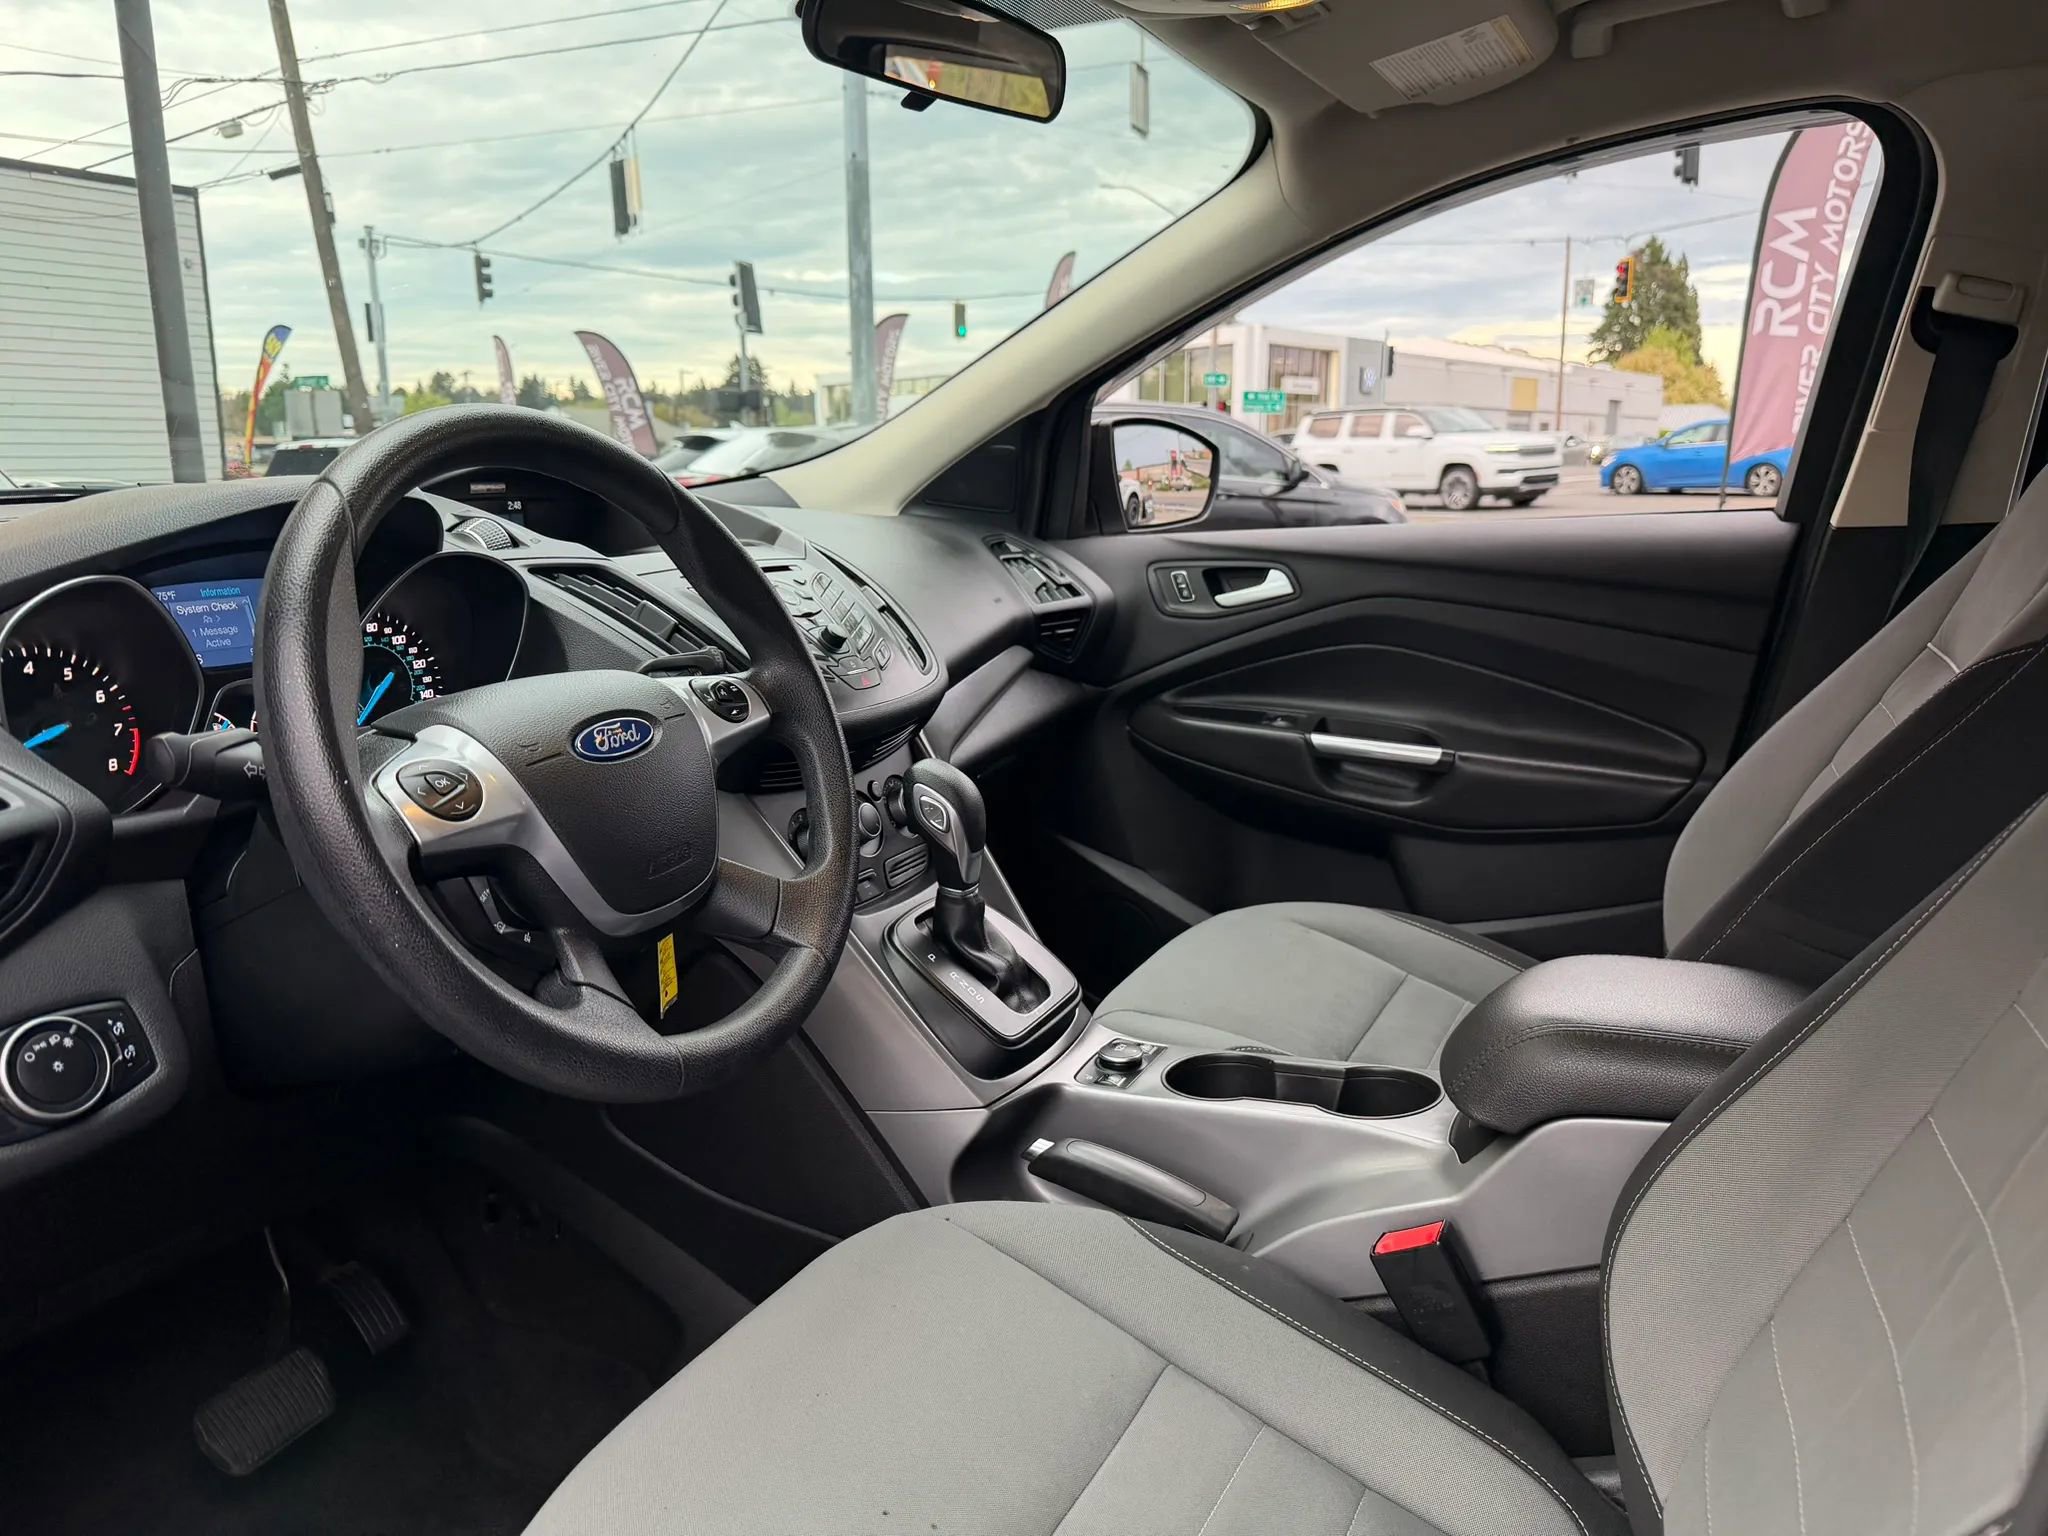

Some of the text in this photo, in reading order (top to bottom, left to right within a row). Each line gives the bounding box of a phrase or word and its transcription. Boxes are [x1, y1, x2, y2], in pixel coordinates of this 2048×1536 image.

[1819, 121, 1872, 256] MOTORS
[1752, 206, 1818, 337] RCM
[1807, 261, 1835, 335] CITY
[604, 381, 622, 412] CITY
[615, 376, 649, 431] RCM
[200, 586, 241, 597] Information
[176, 600, 239, 616] System Check
[199, 624, 239, 637] Message
[366, 623, 378, 632] 80
[205, 637, 232, 648] Active
[392, 635, 406, 645] 100
[23, 660, 34, 675] 4
[412, 659, 426, 669] 120
[63, 667, 73, 681] 5
[96, 690, 106, 703] 6
[420, 689, 434, 699] 140
[114, 722, 123, 736] 7
[593, 722, 641, 752] Ford
[108, 758, 118, 772] 8
[434, 777, 451, 788] OK
[928, 953, 936, 963] P
[950, 971, 959, 980] R
[967, 986, 976, 996] D
[976, 994, 984, 1003] S
